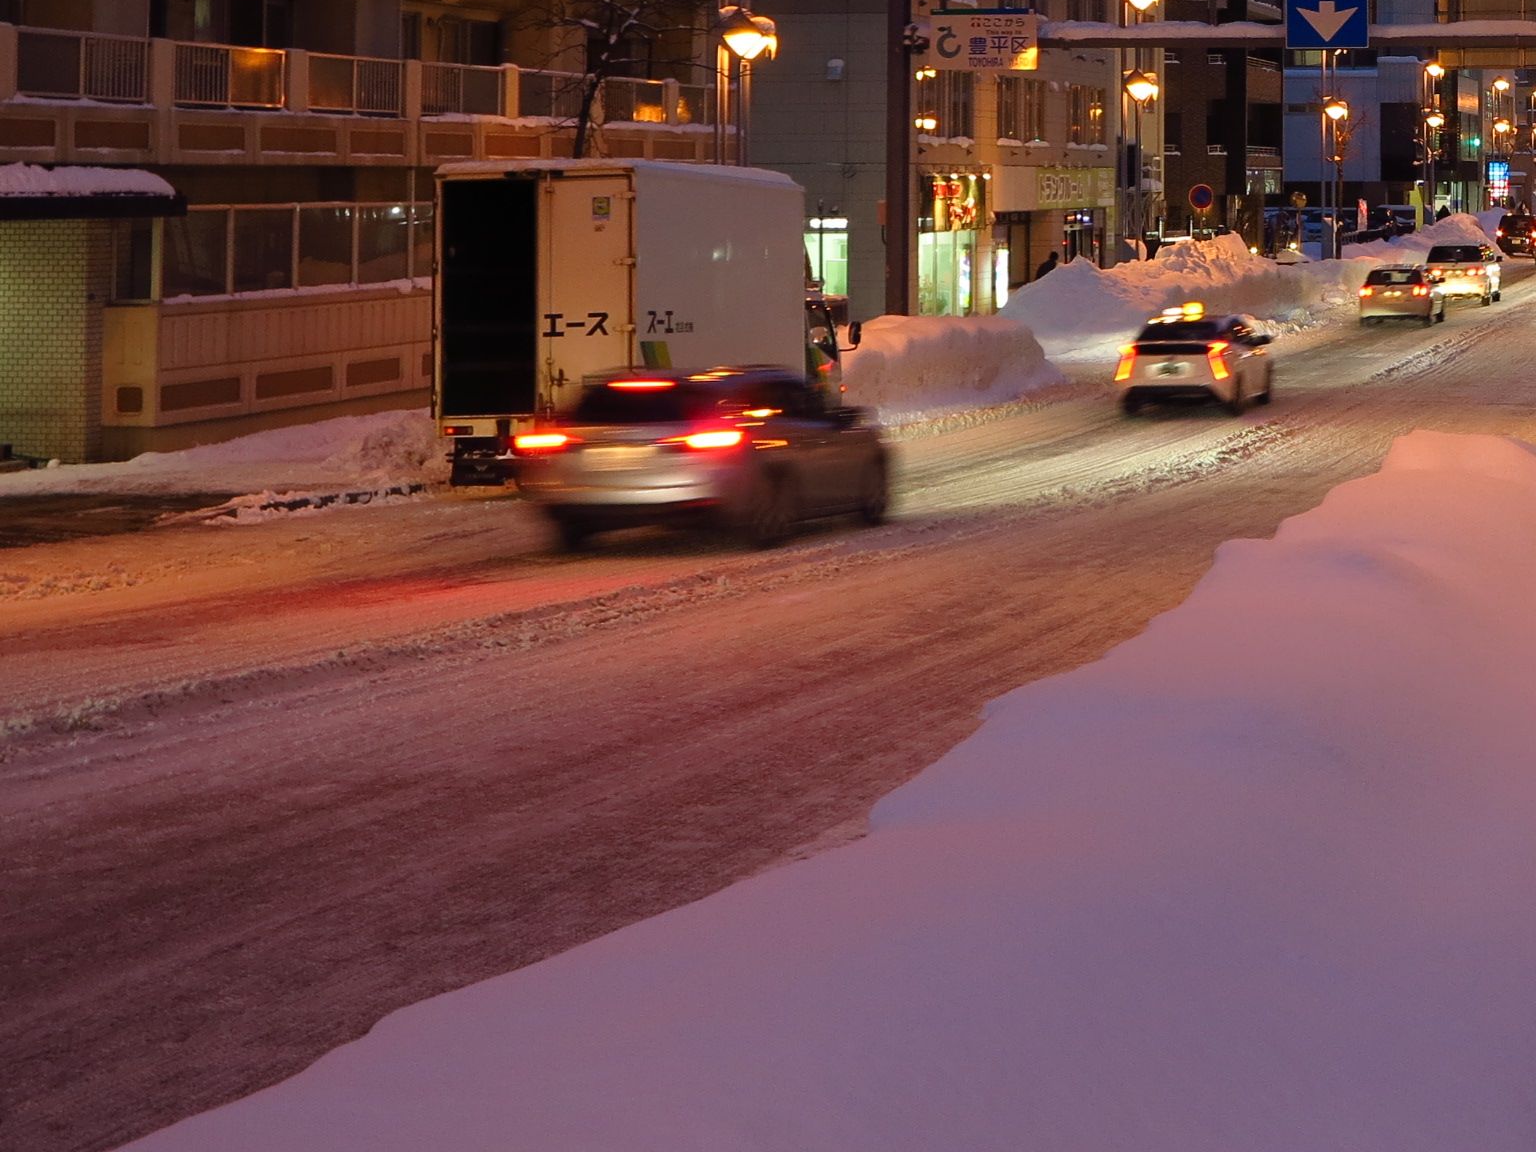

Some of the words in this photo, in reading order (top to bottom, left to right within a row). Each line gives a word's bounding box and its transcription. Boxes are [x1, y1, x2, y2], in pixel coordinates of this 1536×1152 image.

[982, 17, 1025, 27] ここから
[968, 36, 1029, 55] 豊平区
[968, 57, 1003, 68] TOYOHIRA
[542, 312, 609, 337] エース
